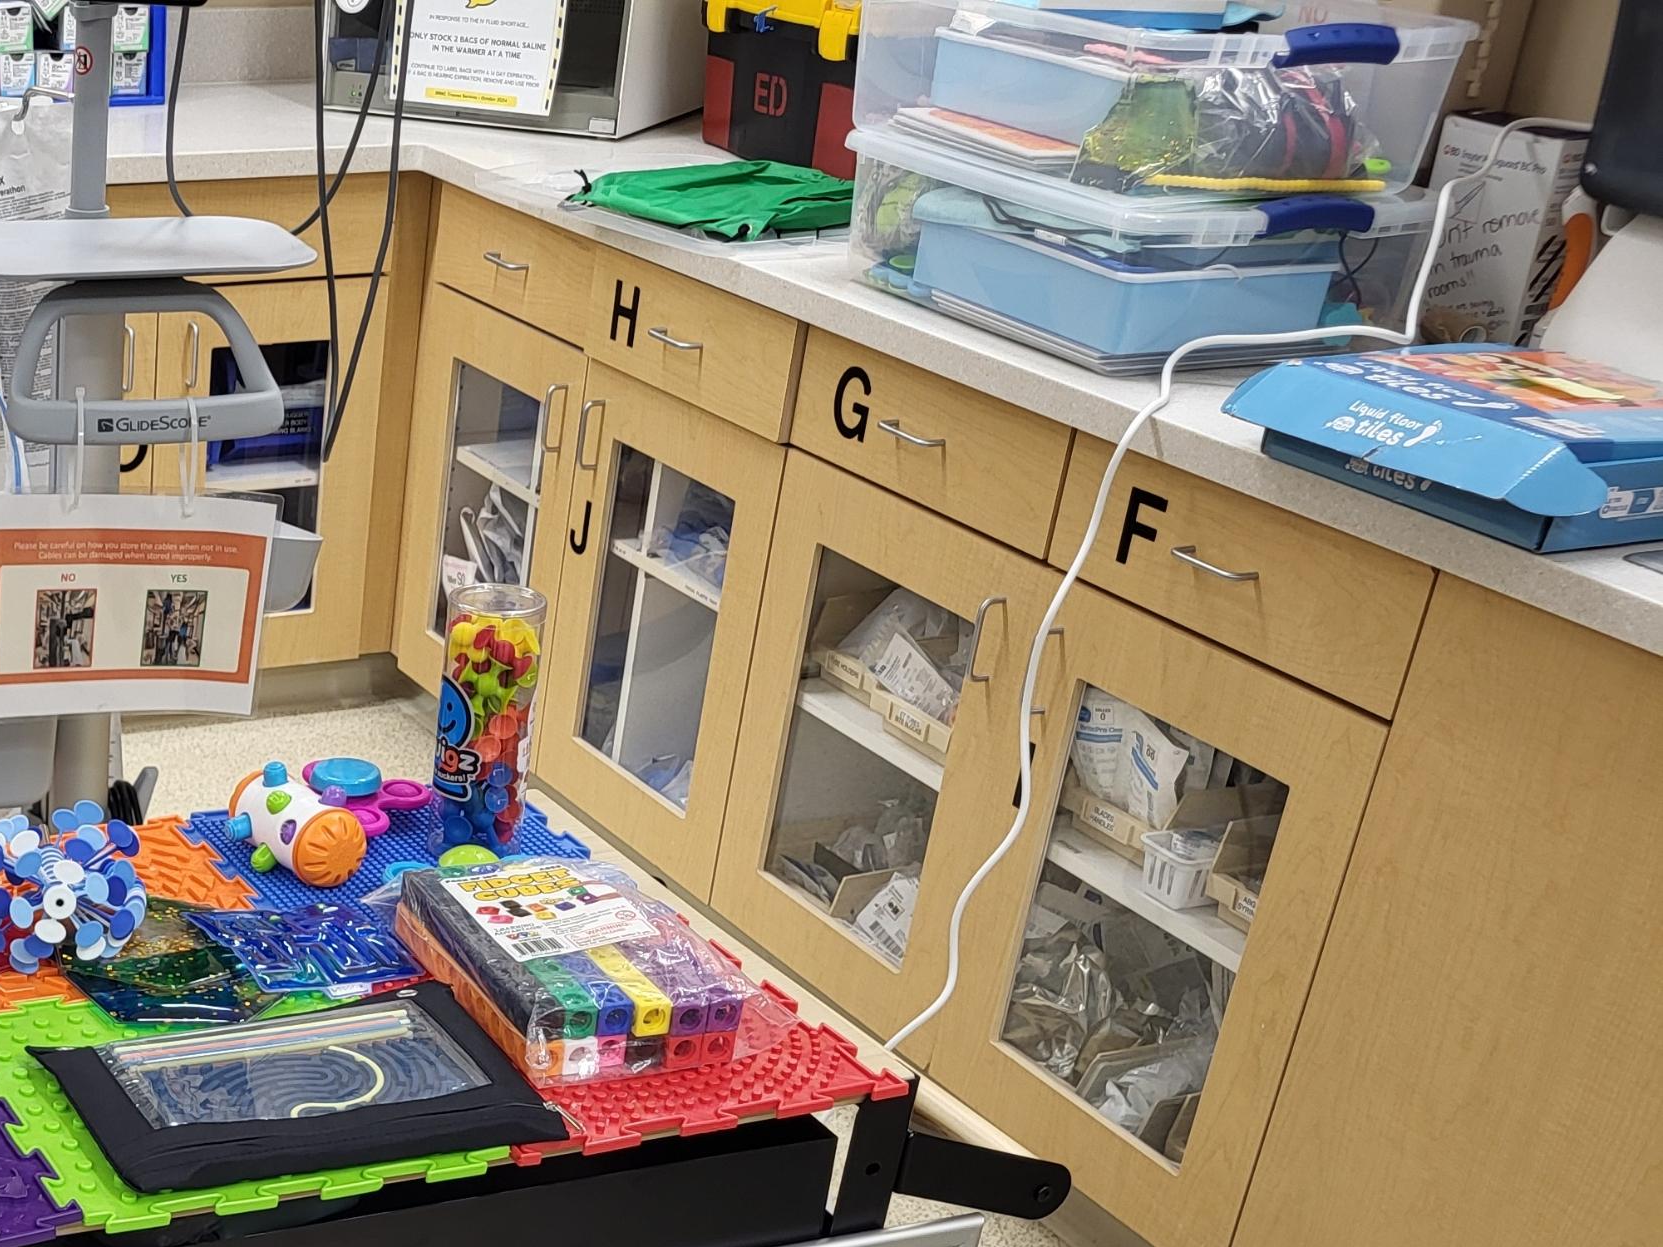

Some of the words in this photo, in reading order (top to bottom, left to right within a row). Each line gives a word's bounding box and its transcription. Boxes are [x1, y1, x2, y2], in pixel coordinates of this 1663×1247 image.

[410, 31, 428, 40] ONLY
[429, 33, 452, 42] STOCK
[454, 35, 459, 43] 2
[460, 36, 478, 45] BAGS
[479, 38, 489, 46] OF
[491, 39, 520, 49] NORMAL
[521, 42, 547, 51] SALINE
[432, 44, 439, 52] IN
[441, 45, 454, 53] THE
[456, 46, 486, 56] WARMER
[487, 49, 497, 57] AT
[505, 51, 522, 60] TIME
[753, 72, 788, 119] ED
[1482, 208, 1540, 234] remove
[1450, 243, 1502, 267] trauma
[610, 279, 641, 348] H
[833, 366, 872, 443] G
[1348, 399, 1386, 422] Liquid
[1389, 411, 1424, 431] floor
[1353, 418, 1404, 447] tiles
[570, 500, 592, 555] J
[1116, 486, 1169, 565] F
[13, 541, 37, 550] Please
[38, 541, 48, 550] be
[49, 541, 75, 550] careful
[87, 541, 103, 549] how
[104, 542, 118, 551] you
[140, 542, 153, 550] the
[154, 542, 177, 551] cables
[179, 542, 199, 551] when
[200, 544, 214, 552] not
[215, 544, 222, 552] in
[39, 551, 63, 559] Cables
[78, 551, 88, 559] be
[89, 551, 123, 562] damaged
[146, 551, 170, 560] stored
[60, 573, 76, 583] NO
[170, 573, 187, 583] YES
[1090, 814, 1115, 832] HANDLES
[1094, 806, 1115, 822] BLADES
[457, 868, 571, 892] FIDGET
[473, 877, 581, 901] CUBES
